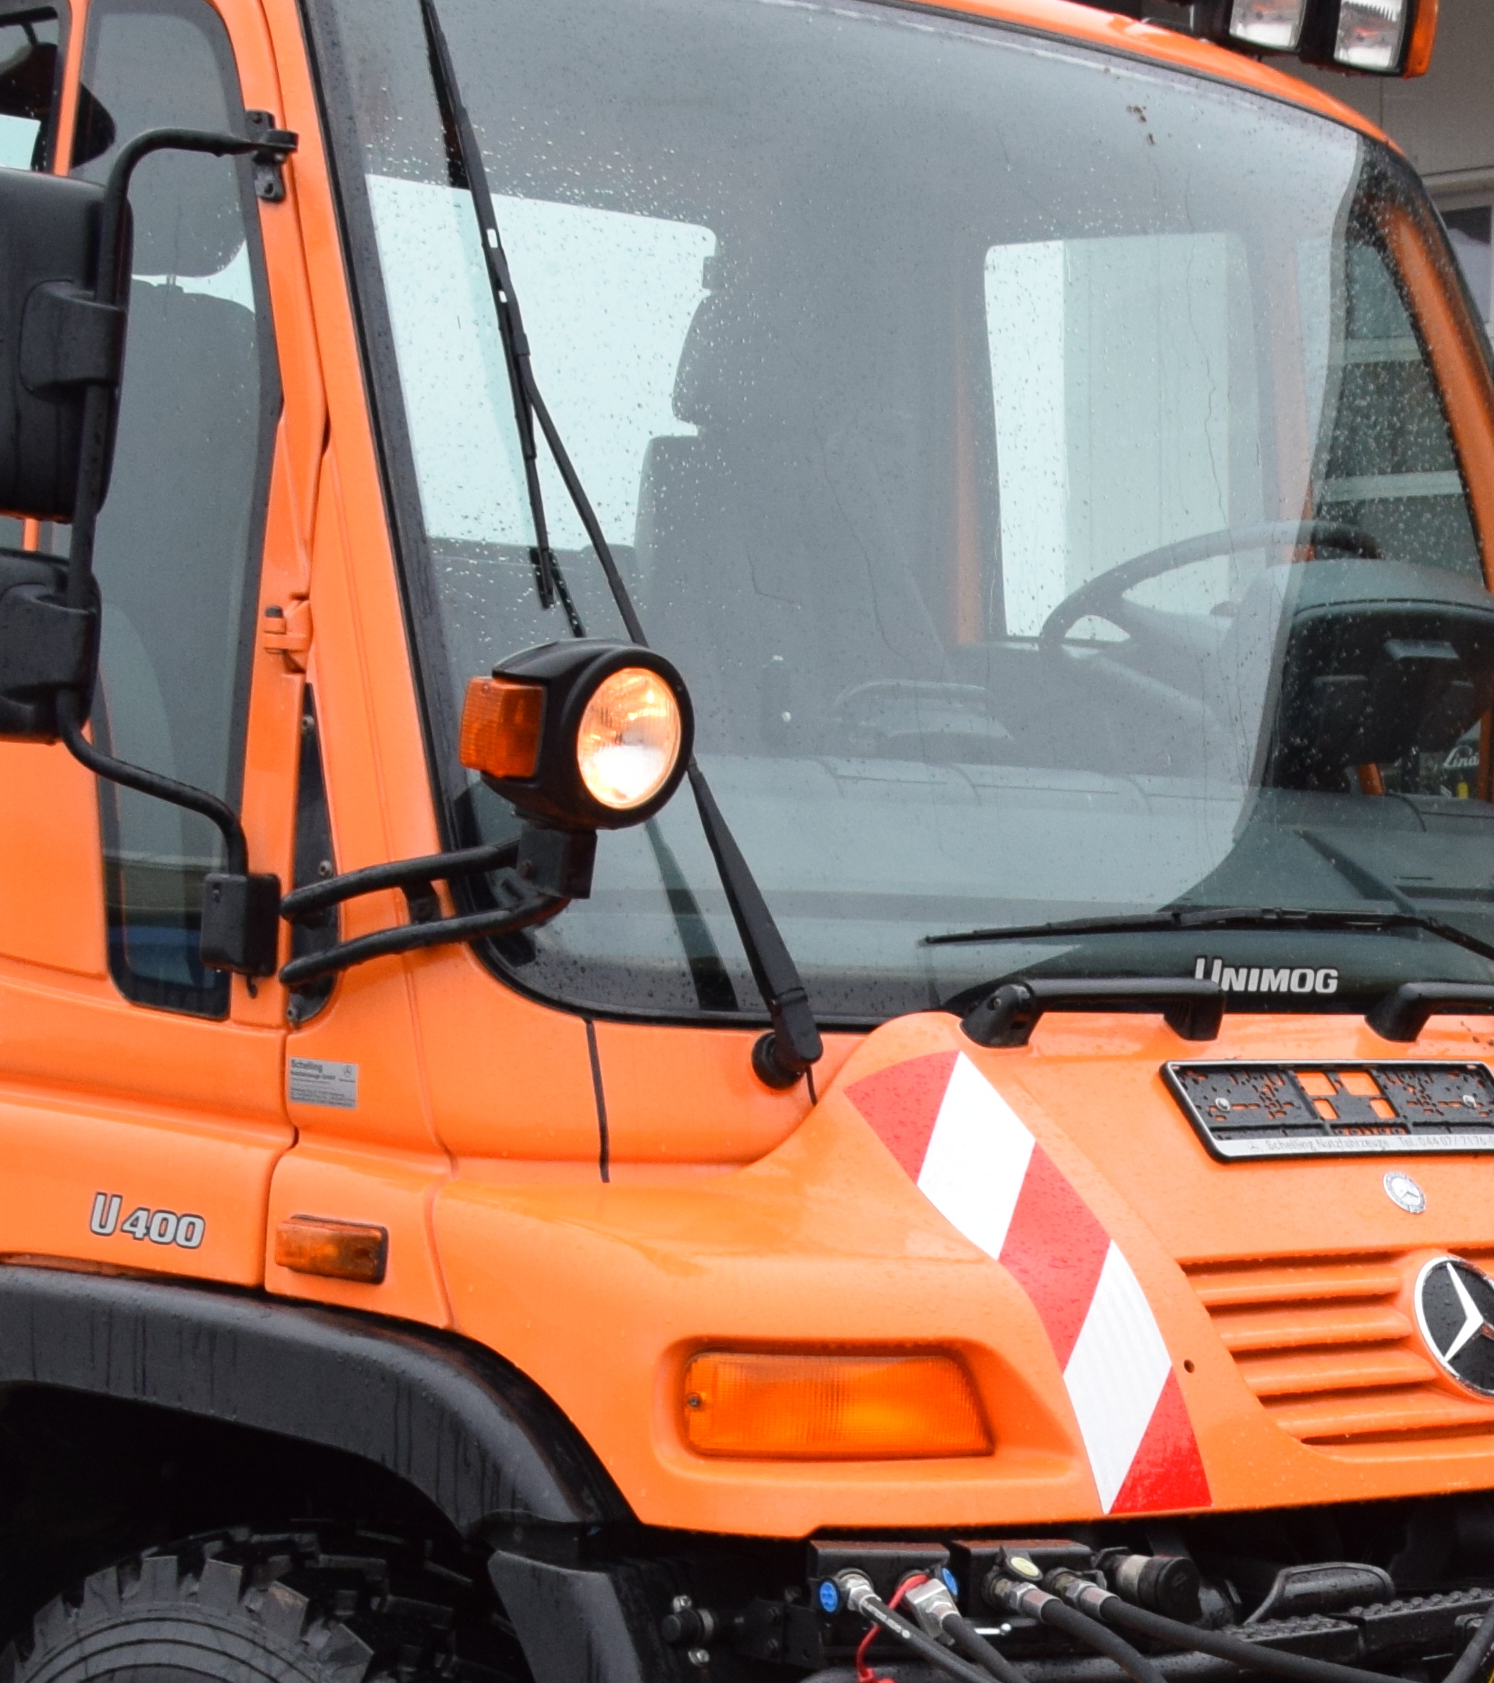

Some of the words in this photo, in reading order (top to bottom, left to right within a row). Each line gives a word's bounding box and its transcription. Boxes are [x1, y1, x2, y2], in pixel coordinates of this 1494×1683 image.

[1443, 744, 1480, 768] Lind
[90, 1191, 123, 1237] U
[120, 1206, 206, 1250] 400
